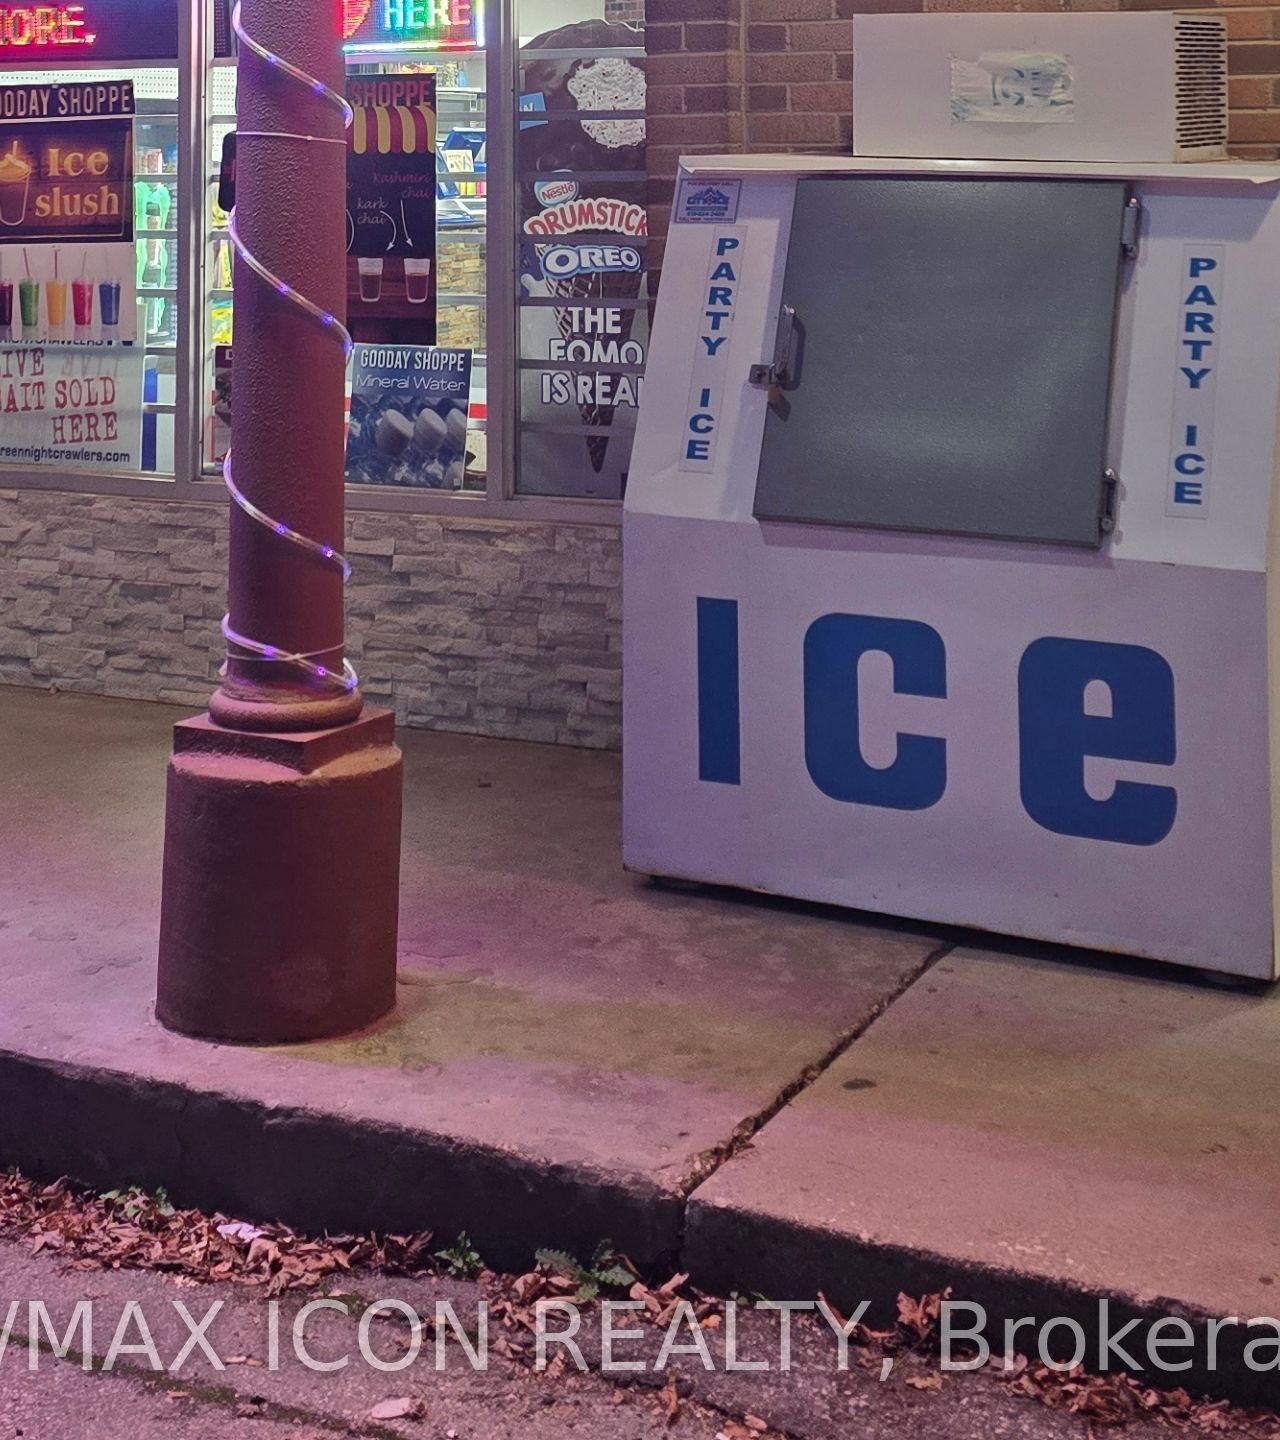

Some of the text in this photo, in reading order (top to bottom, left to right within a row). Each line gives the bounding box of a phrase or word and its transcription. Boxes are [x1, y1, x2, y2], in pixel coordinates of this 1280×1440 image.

[56, 85, 131, 115] SHOPPE
[349, 80, 433, 108] SHOPPE
[46, 147, 110, 178] Ice
[34, 184, 121, 217] slush
[527, 198, 649, 236] DRUMSTICK
[545, 247, 640, 274] OREO
[699, 237, 740, 357] PARTY
[567, 307, 622, 334] THE
[1180, 256, 1218, 391] PARTY
[360, 348, 465, 373] GOODAY SHOPPE
[54, 376, 116, 410] SOLD
[356, 372, 467, 393] Mineral Water
[541, 372, 570, 405] IS
[51, 411, 118, 445] HERE
[686, 388, 716, 461] ICE
[1174, 424, 1206, 505] ICE
